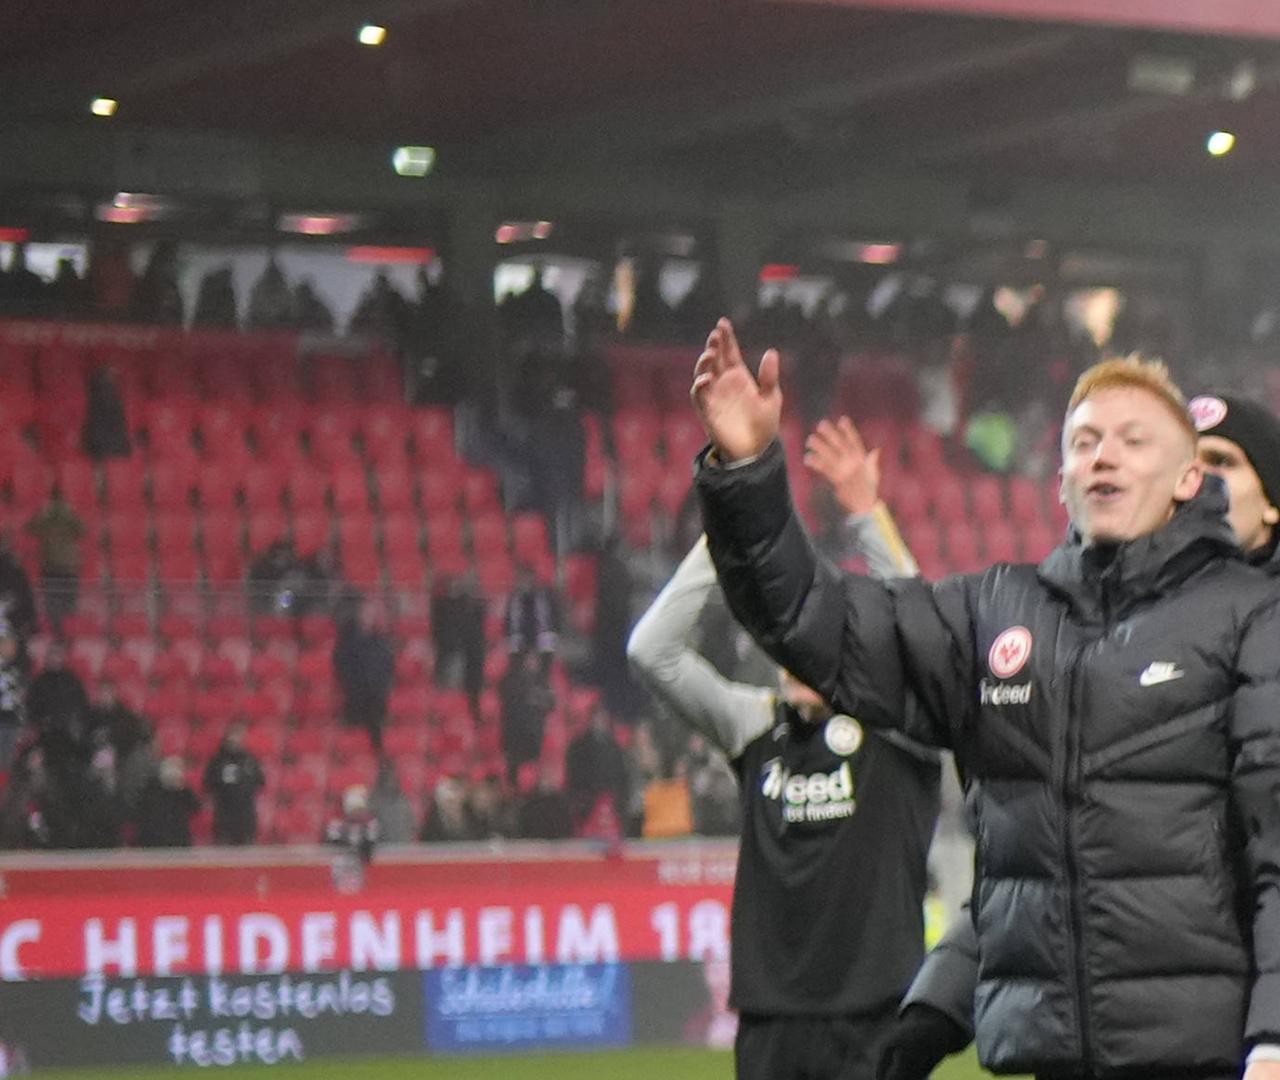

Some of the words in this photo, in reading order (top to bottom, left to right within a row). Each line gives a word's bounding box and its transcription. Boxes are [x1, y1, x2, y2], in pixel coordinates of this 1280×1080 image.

[84, 903, 621, 979] HEIDENHEIM
[78, 970, 200, 1025] Jetzt
[207, 968, 396, 1021] kostenlos
[169, 1023, 304, 1066] testen
